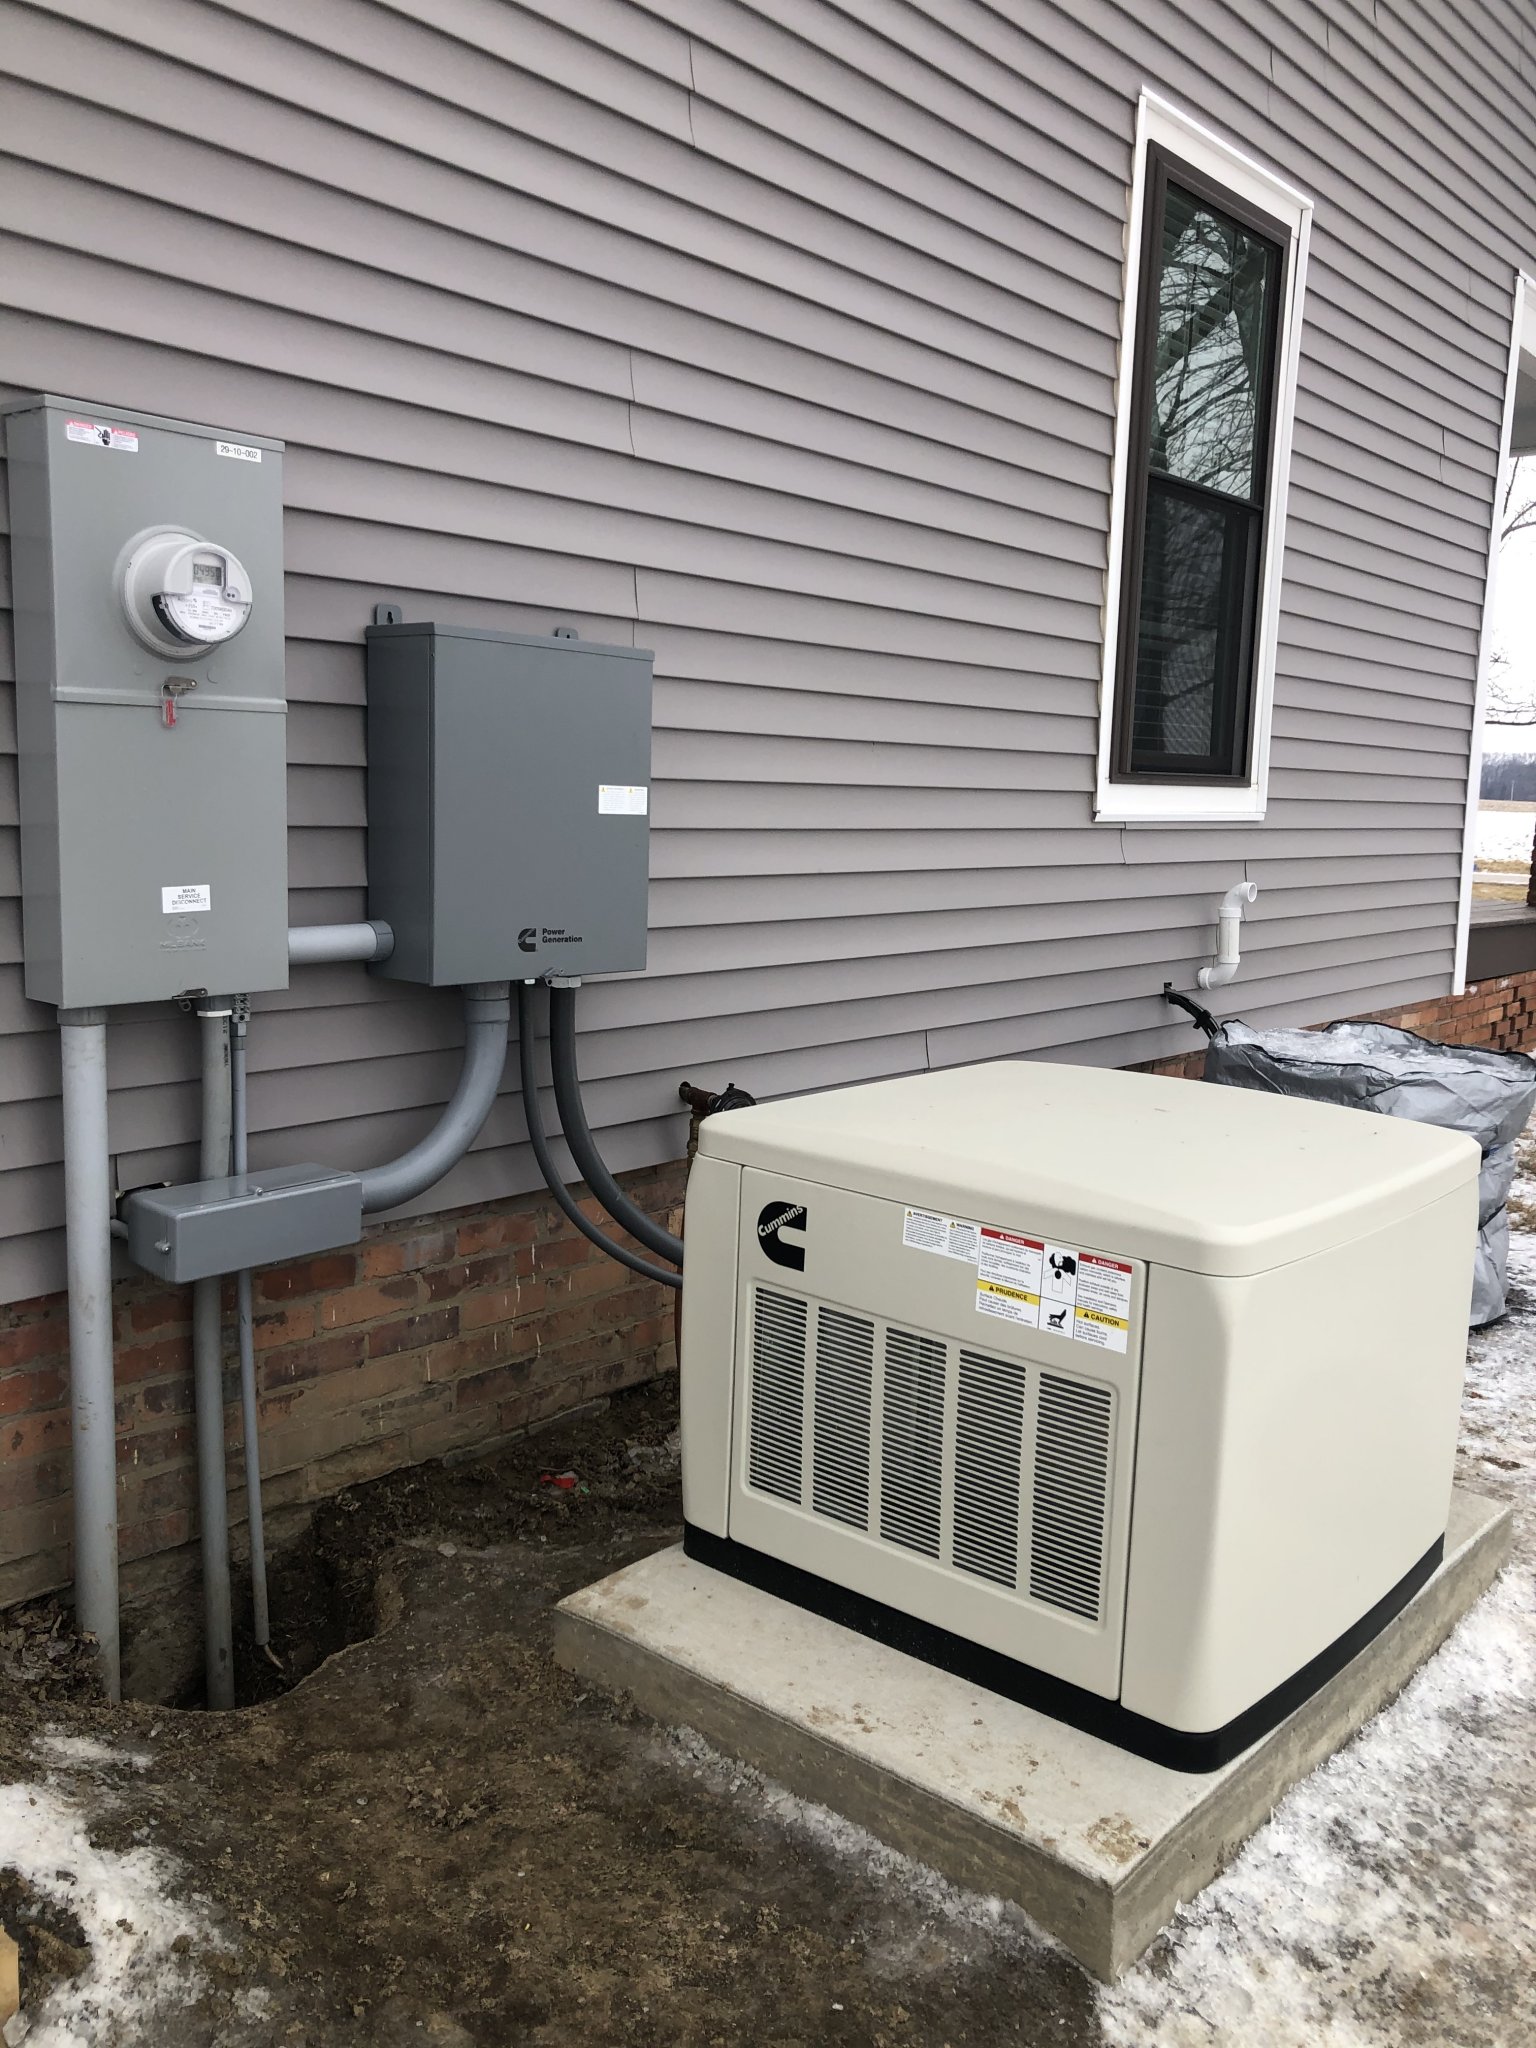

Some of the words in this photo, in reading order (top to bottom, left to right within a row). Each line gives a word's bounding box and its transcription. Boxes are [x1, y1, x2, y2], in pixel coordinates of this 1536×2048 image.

[220, 444, 258, 459] 29-10-002
[542, 927, 566, 935] Power
[542, 935, 583, 943] Generation
[758, 1205, 804, 1237] Cummins
[1097, 1259, 1119, 1269] DANGER
[995, 1286, 1028, 1301] PRUDENCE
[1090, 1313, 1120, 1327] CAUTION
